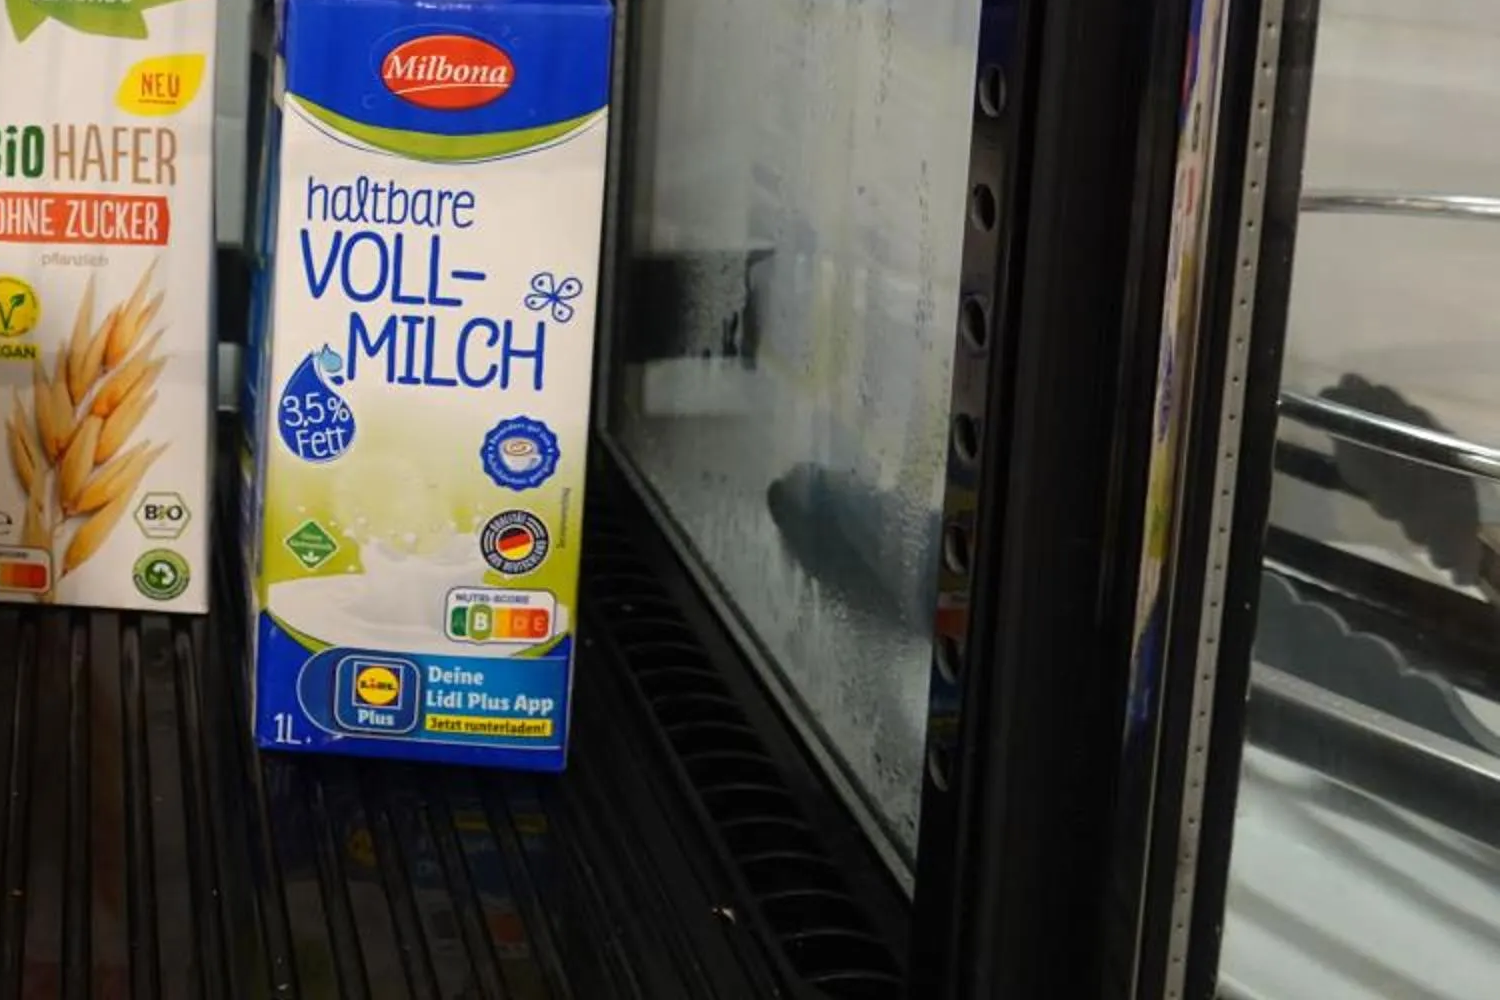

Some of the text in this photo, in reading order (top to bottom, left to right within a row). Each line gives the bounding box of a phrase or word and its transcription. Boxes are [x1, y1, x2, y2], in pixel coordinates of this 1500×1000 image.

[140, 71, 181, 100] NEU
[384, 54, 509, 86] Milbona
[52, 123, 178, 187] HAFER
[306, 175, 476, 230] haltbare
[64, 197, 160, 242] ZUCKER
[299, 228, 487, 308] VOLL-
[345, 311, 547, 392] MILCH
[295, 426, 347, 458] Fett
[426, 665, 485, 686] Deine
[357, 708, 395, 727] Plus
[426, 689, 555, 716] Lidl Plus App
